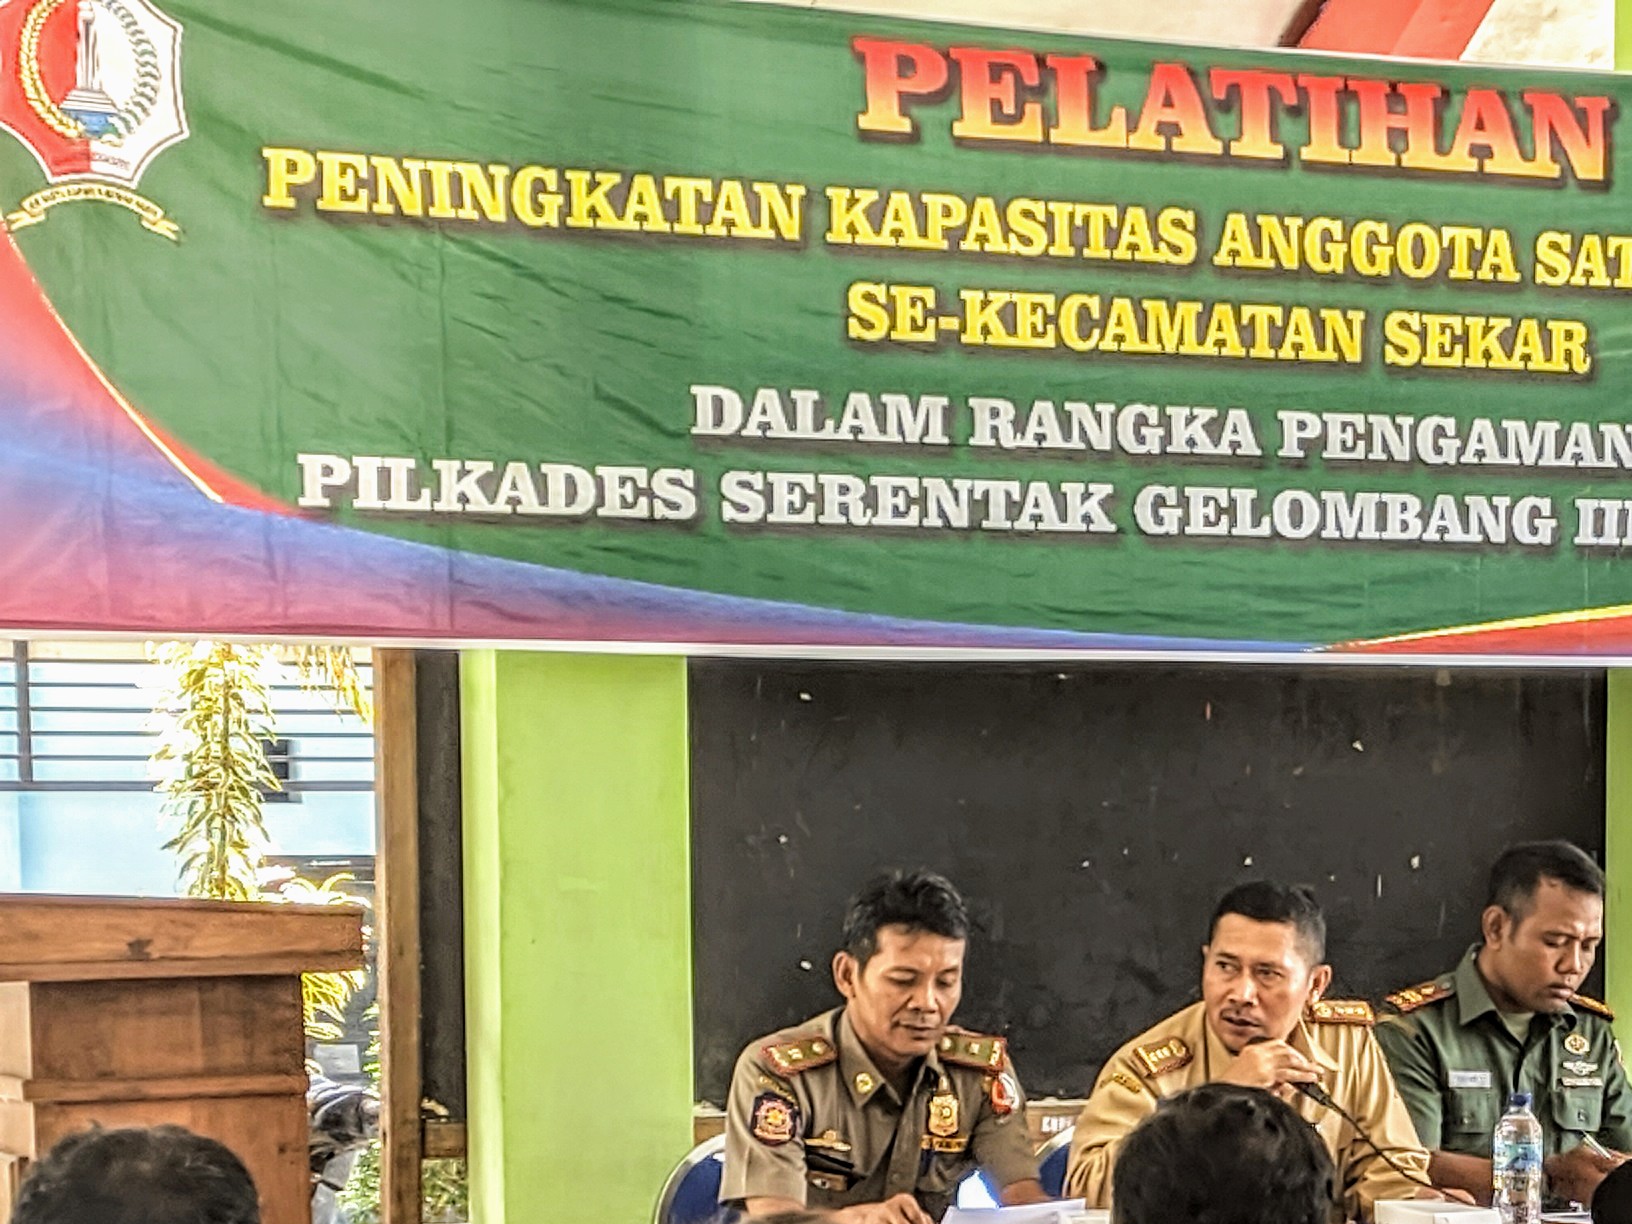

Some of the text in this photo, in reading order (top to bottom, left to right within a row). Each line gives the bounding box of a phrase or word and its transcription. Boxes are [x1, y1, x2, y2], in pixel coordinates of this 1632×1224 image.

[852, 36, 1611, 182] PELATIHAN
[260, 146, 805, 242] PENINGKATAN
[825, 185, 1198, 266] KAPASITAS
[1213, 212, 1521, 285] ANGGOTA
[846, 281, 1593, 375] SE-KECAMATAN SEKAR
[690, 384, 949, 446] DALAM
[969, 396, 1262, 458] RANGKA
[296, 452, 699, 522] PILKADES
[720, 470, 1118, 534] SERENTAK
[1133, 483, 1557, 547] GELOMBANG
